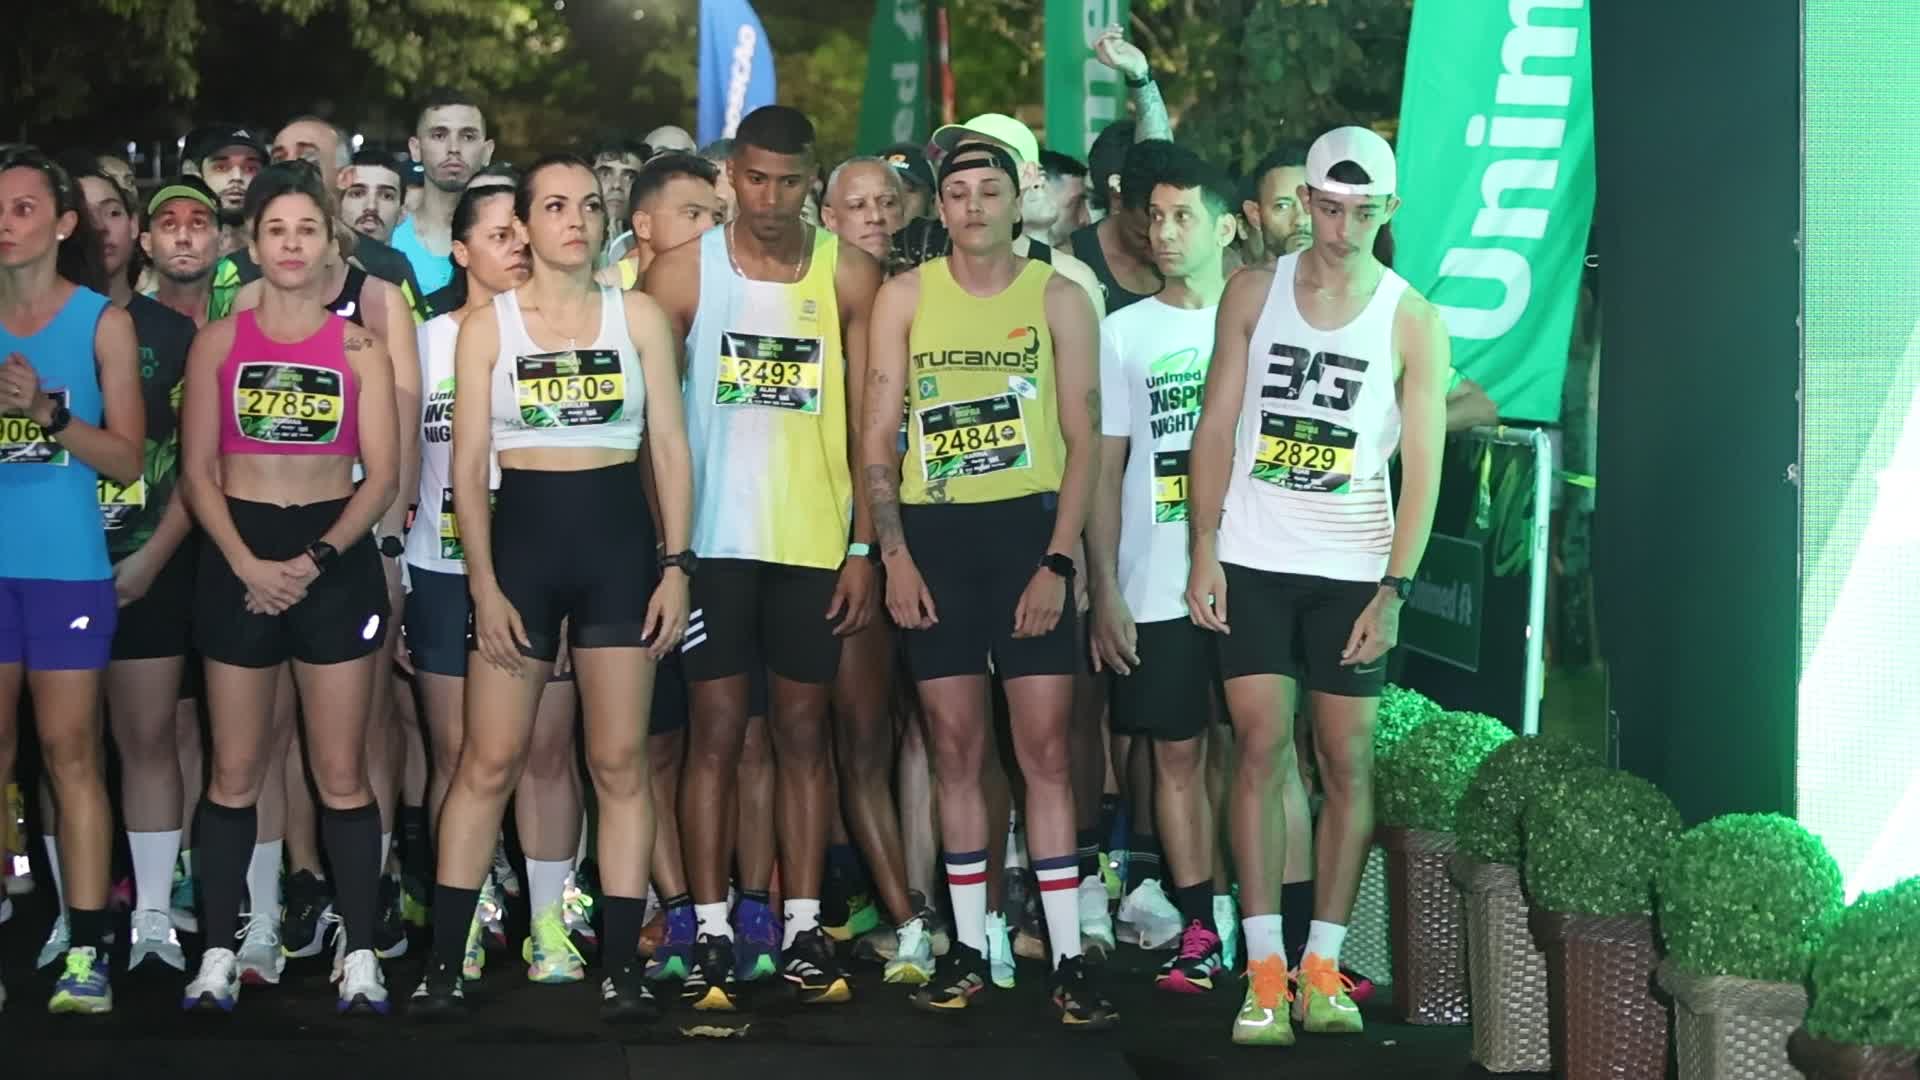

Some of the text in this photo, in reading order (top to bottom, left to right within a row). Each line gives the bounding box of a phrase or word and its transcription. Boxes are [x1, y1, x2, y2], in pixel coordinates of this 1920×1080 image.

[1429, 0, 1584, 340] Unim
[738, 359, 802, 386] 2493
[1145, 369, 1202, 390] Unimed
[531, 376, 598, 402] 1050
[247, 390, 316, 418] 2785
[1151, 411, 1196, 440] NIGHT
[933, 424, 1000, 456] 2484
[1272, 439, 1337, 471] 2829
[1173, 477, 1184, 498] 1
